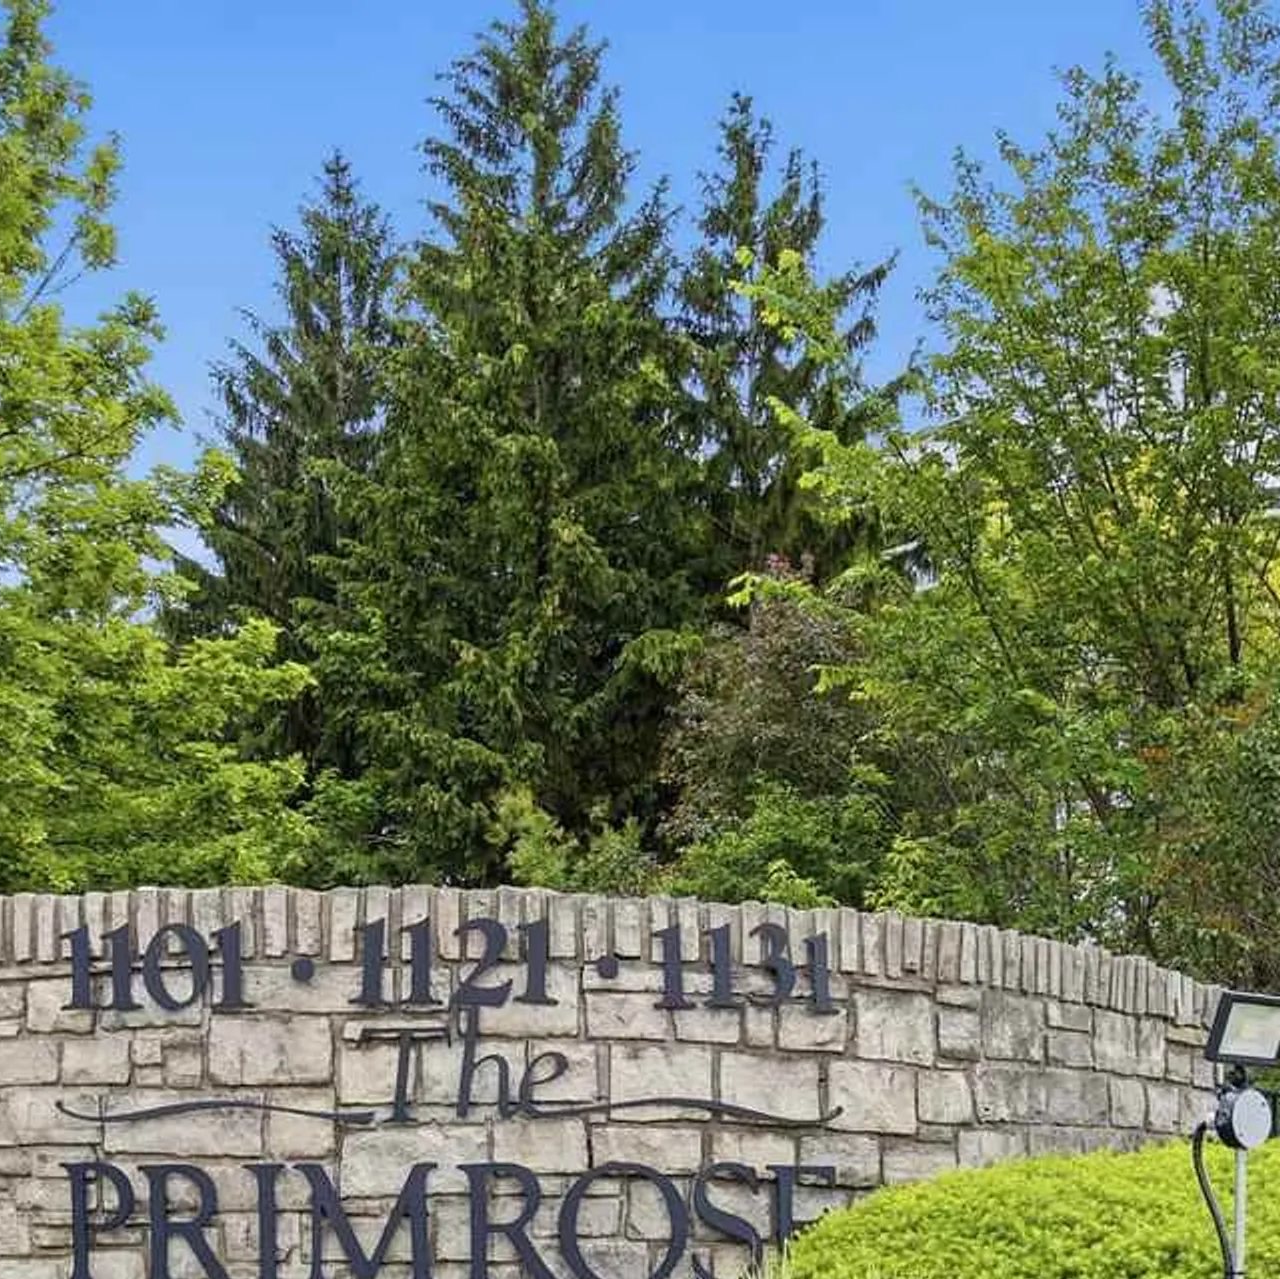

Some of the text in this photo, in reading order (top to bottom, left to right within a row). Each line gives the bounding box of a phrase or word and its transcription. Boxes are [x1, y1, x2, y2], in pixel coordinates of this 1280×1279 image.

[60, 915, 842, 1016] 1101 1121 1131
[361, 1004, 570, 1123] The
